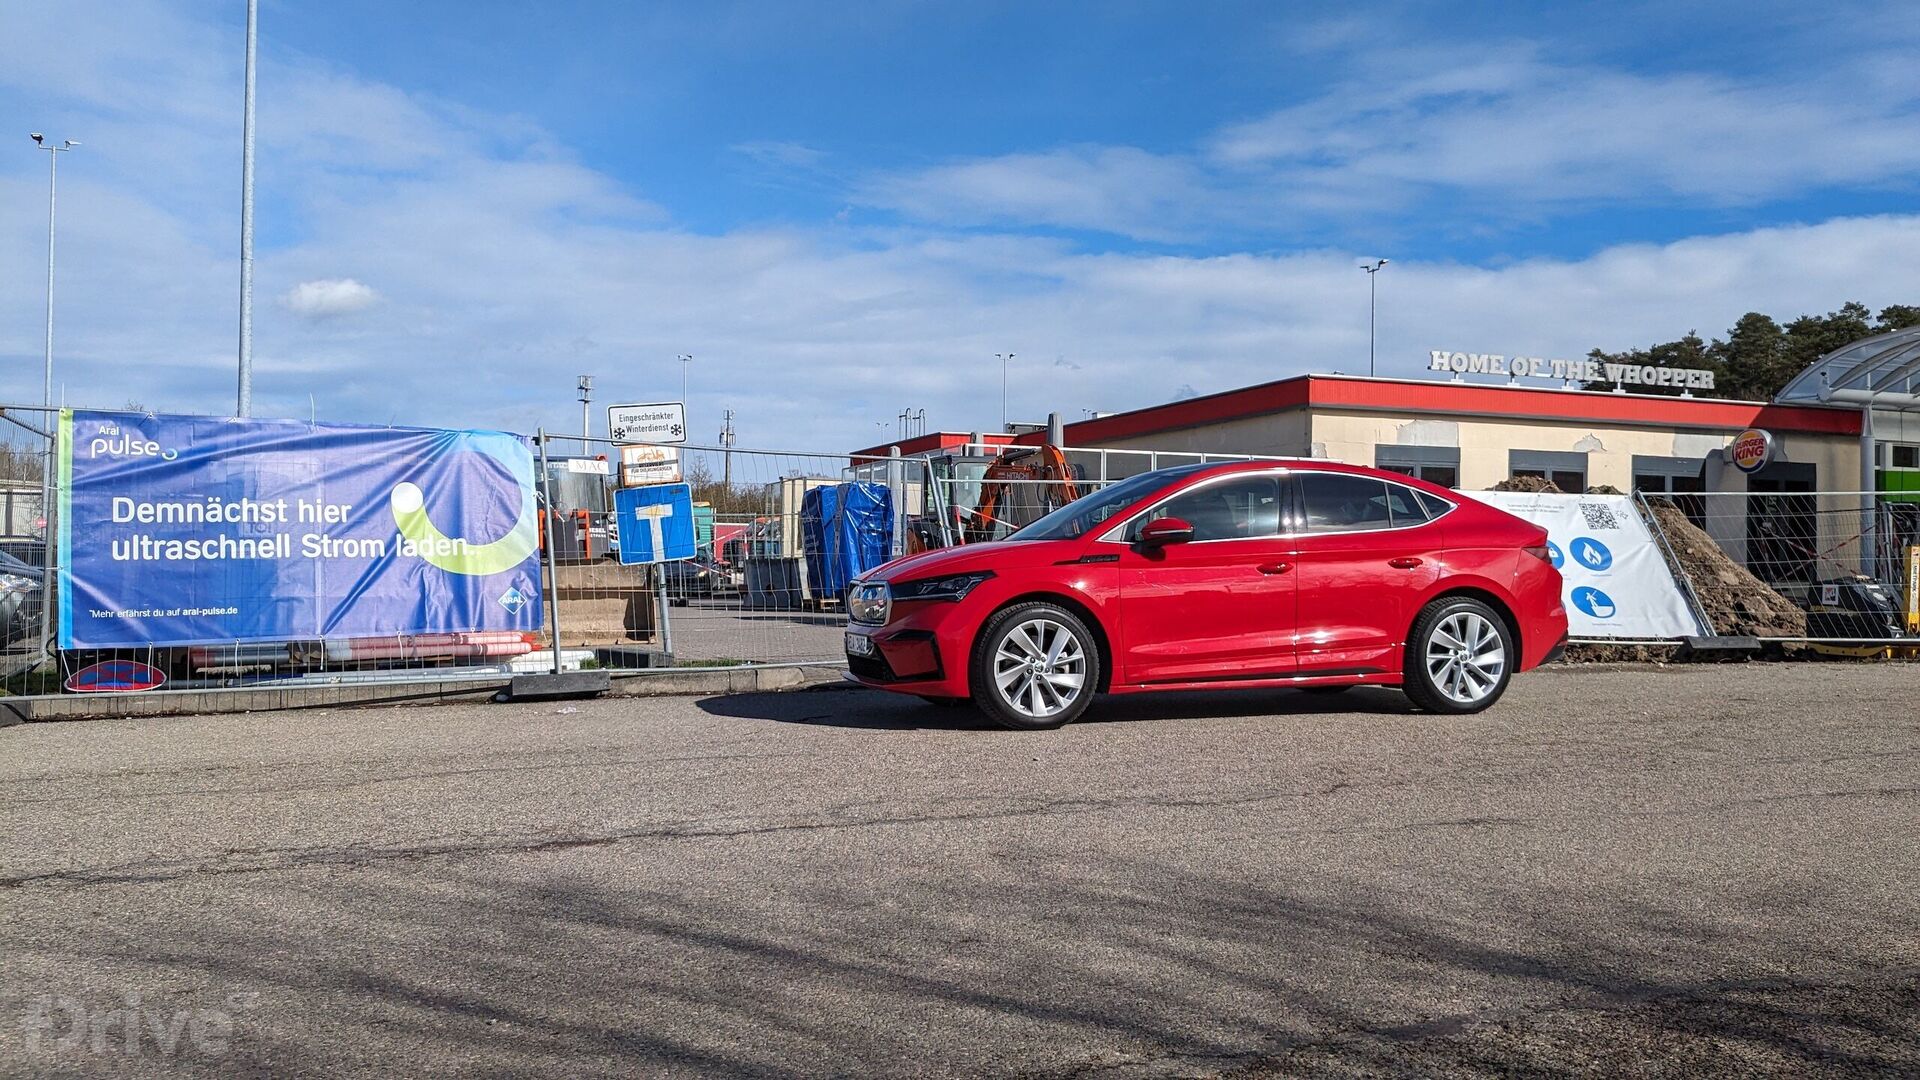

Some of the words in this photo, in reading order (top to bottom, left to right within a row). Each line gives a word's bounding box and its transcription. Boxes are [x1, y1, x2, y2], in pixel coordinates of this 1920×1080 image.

[1430, 350, 1504, 374] HOME
[1510, 356, 1543, 377] OF
[1548, 359, 1599, 381] THE
[1603, 362, 1715, 389] WHOPPER
[618, 412, 674, 423] Eingeschränkter
[98, 425, 119, 436] Aral
[625, 423, 669, 433] Winterdienst
[91, 434, 160, 458] pulse
[1735, 438, 1764, 450] BURGER
[1735, 446, 1764, 460] KING
[112, 496, 288, 523] Demnächst
[298, 498, 352, 523] hier
[112, 533, 291, 560] ultraschnell
[301, 533, 385, 558] Strom
[502, 595, 523, 604] ARAL
[117, 609, 151, 618] erfährst
[153, 608, 164, 617] du
[166, 608, 181, 617] auf
[182, 606, 238, 617] aral-pulse.de
